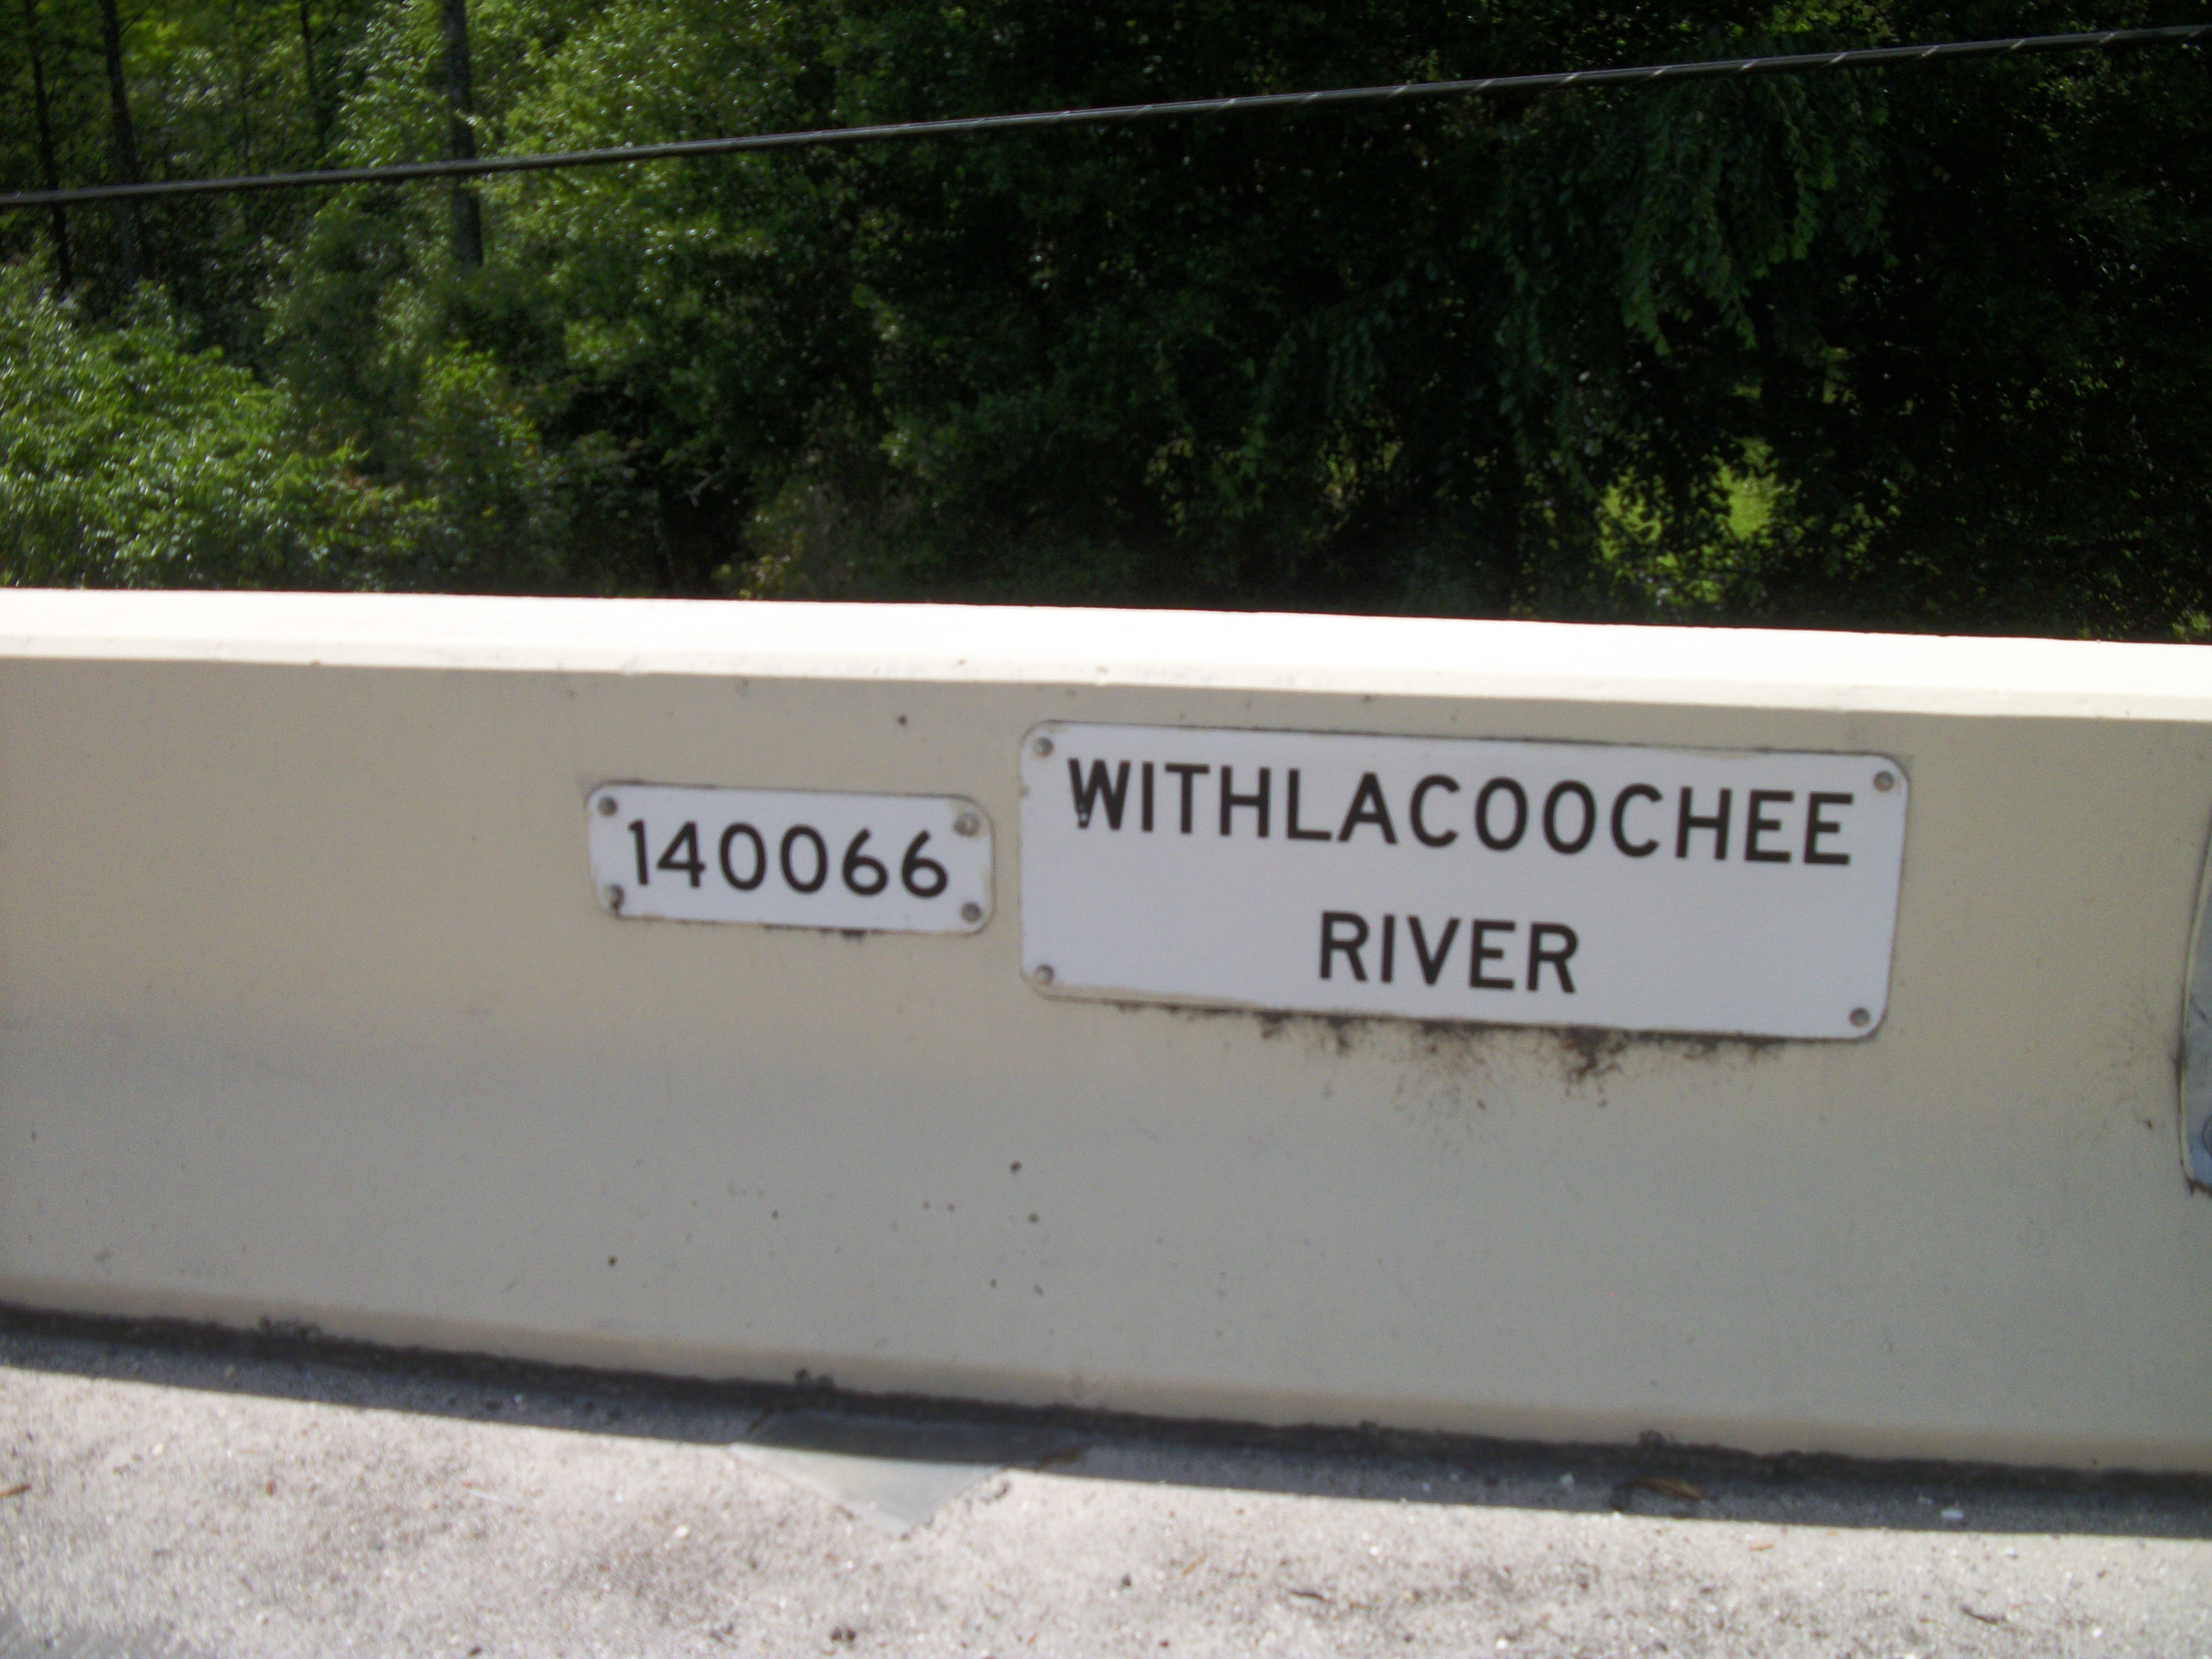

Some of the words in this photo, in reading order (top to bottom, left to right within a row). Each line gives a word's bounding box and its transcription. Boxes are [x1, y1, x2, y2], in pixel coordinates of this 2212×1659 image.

[1068, 758, 1854, 866] WITHLACOOCHEE
[628, 820, 949, 899] 140066
[1319, 911, 1579, 994] RIVER
